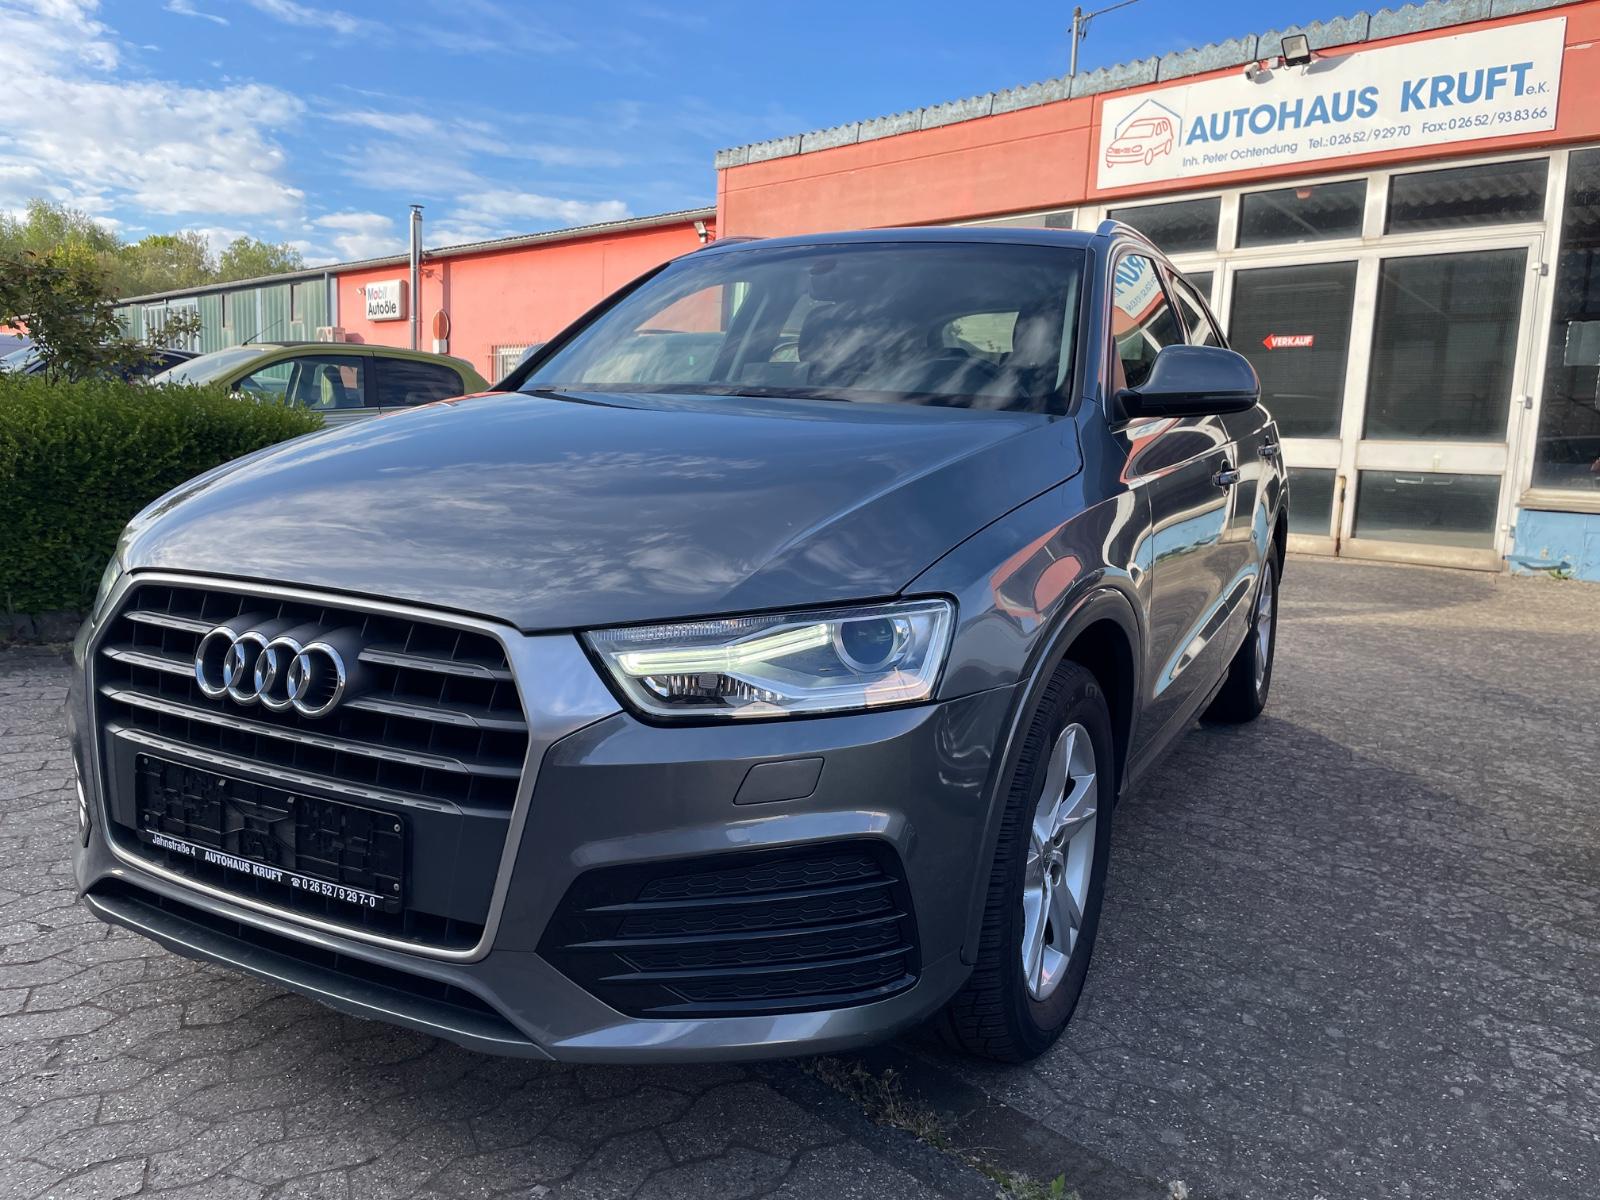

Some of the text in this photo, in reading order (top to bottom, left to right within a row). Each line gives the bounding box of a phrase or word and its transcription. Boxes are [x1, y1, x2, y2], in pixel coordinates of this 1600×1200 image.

[1185, 61, 1550, 146] AUTOHAUS KRUFT e.K.
[1183, 156, 1200, 168] Inh.
[1202, 151, 1227, 165] Peter
[1230, 142, 1298, 161] Ochtendung
[367, 286, 388, 301] Mobil
[367, 300, 397, 316] Autoöle
[1271, 335, 1313, 347] VERKAUF
[152, 834, 190, 855] Jahnstraße
[190, 846, 196, 857] 4
[204, 851, 251, 873] AUTOHAUS
[252, 864, 283, 882] KRUFT
